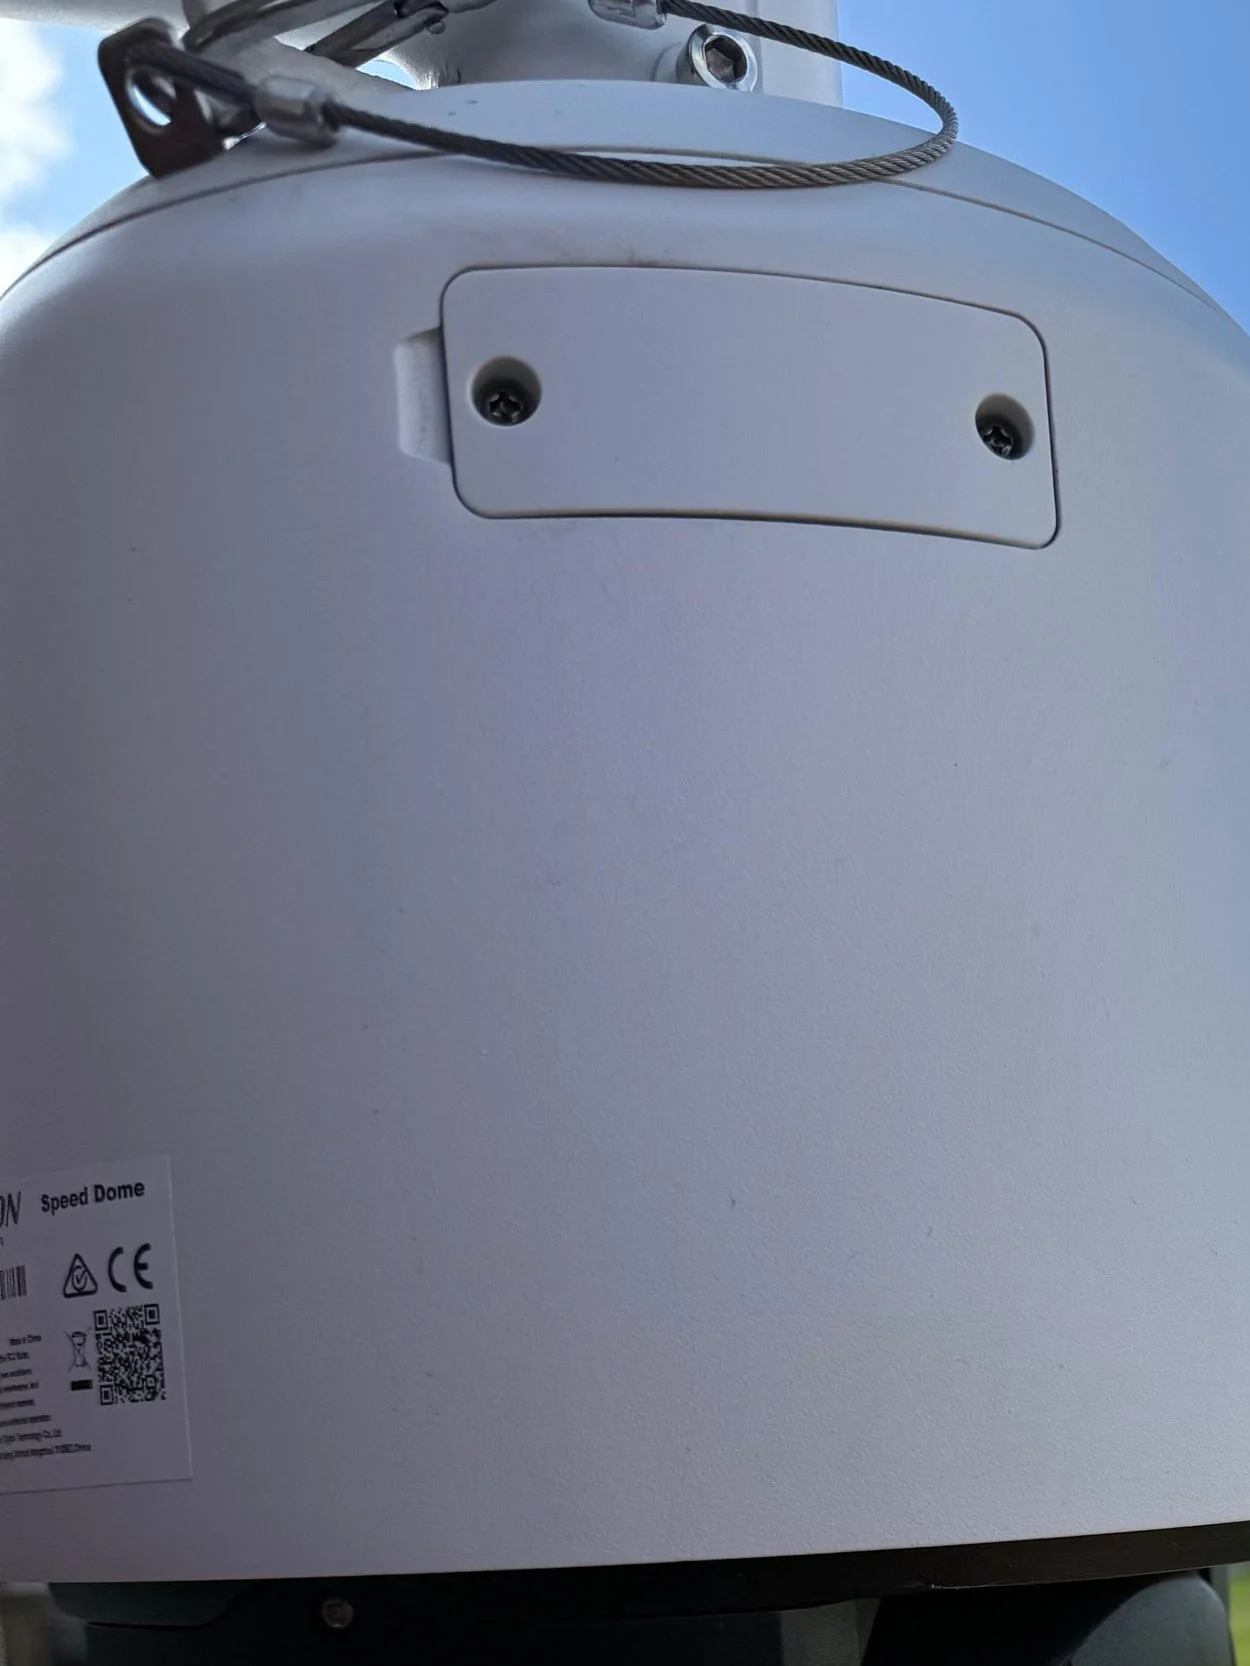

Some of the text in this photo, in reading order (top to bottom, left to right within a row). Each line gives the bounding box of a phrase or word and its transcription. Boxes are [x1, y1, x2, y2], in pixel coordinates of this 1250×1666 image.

[41, 1182, 146, 1216] Speed Dome
[108, 1243, 154, 1293] CE
